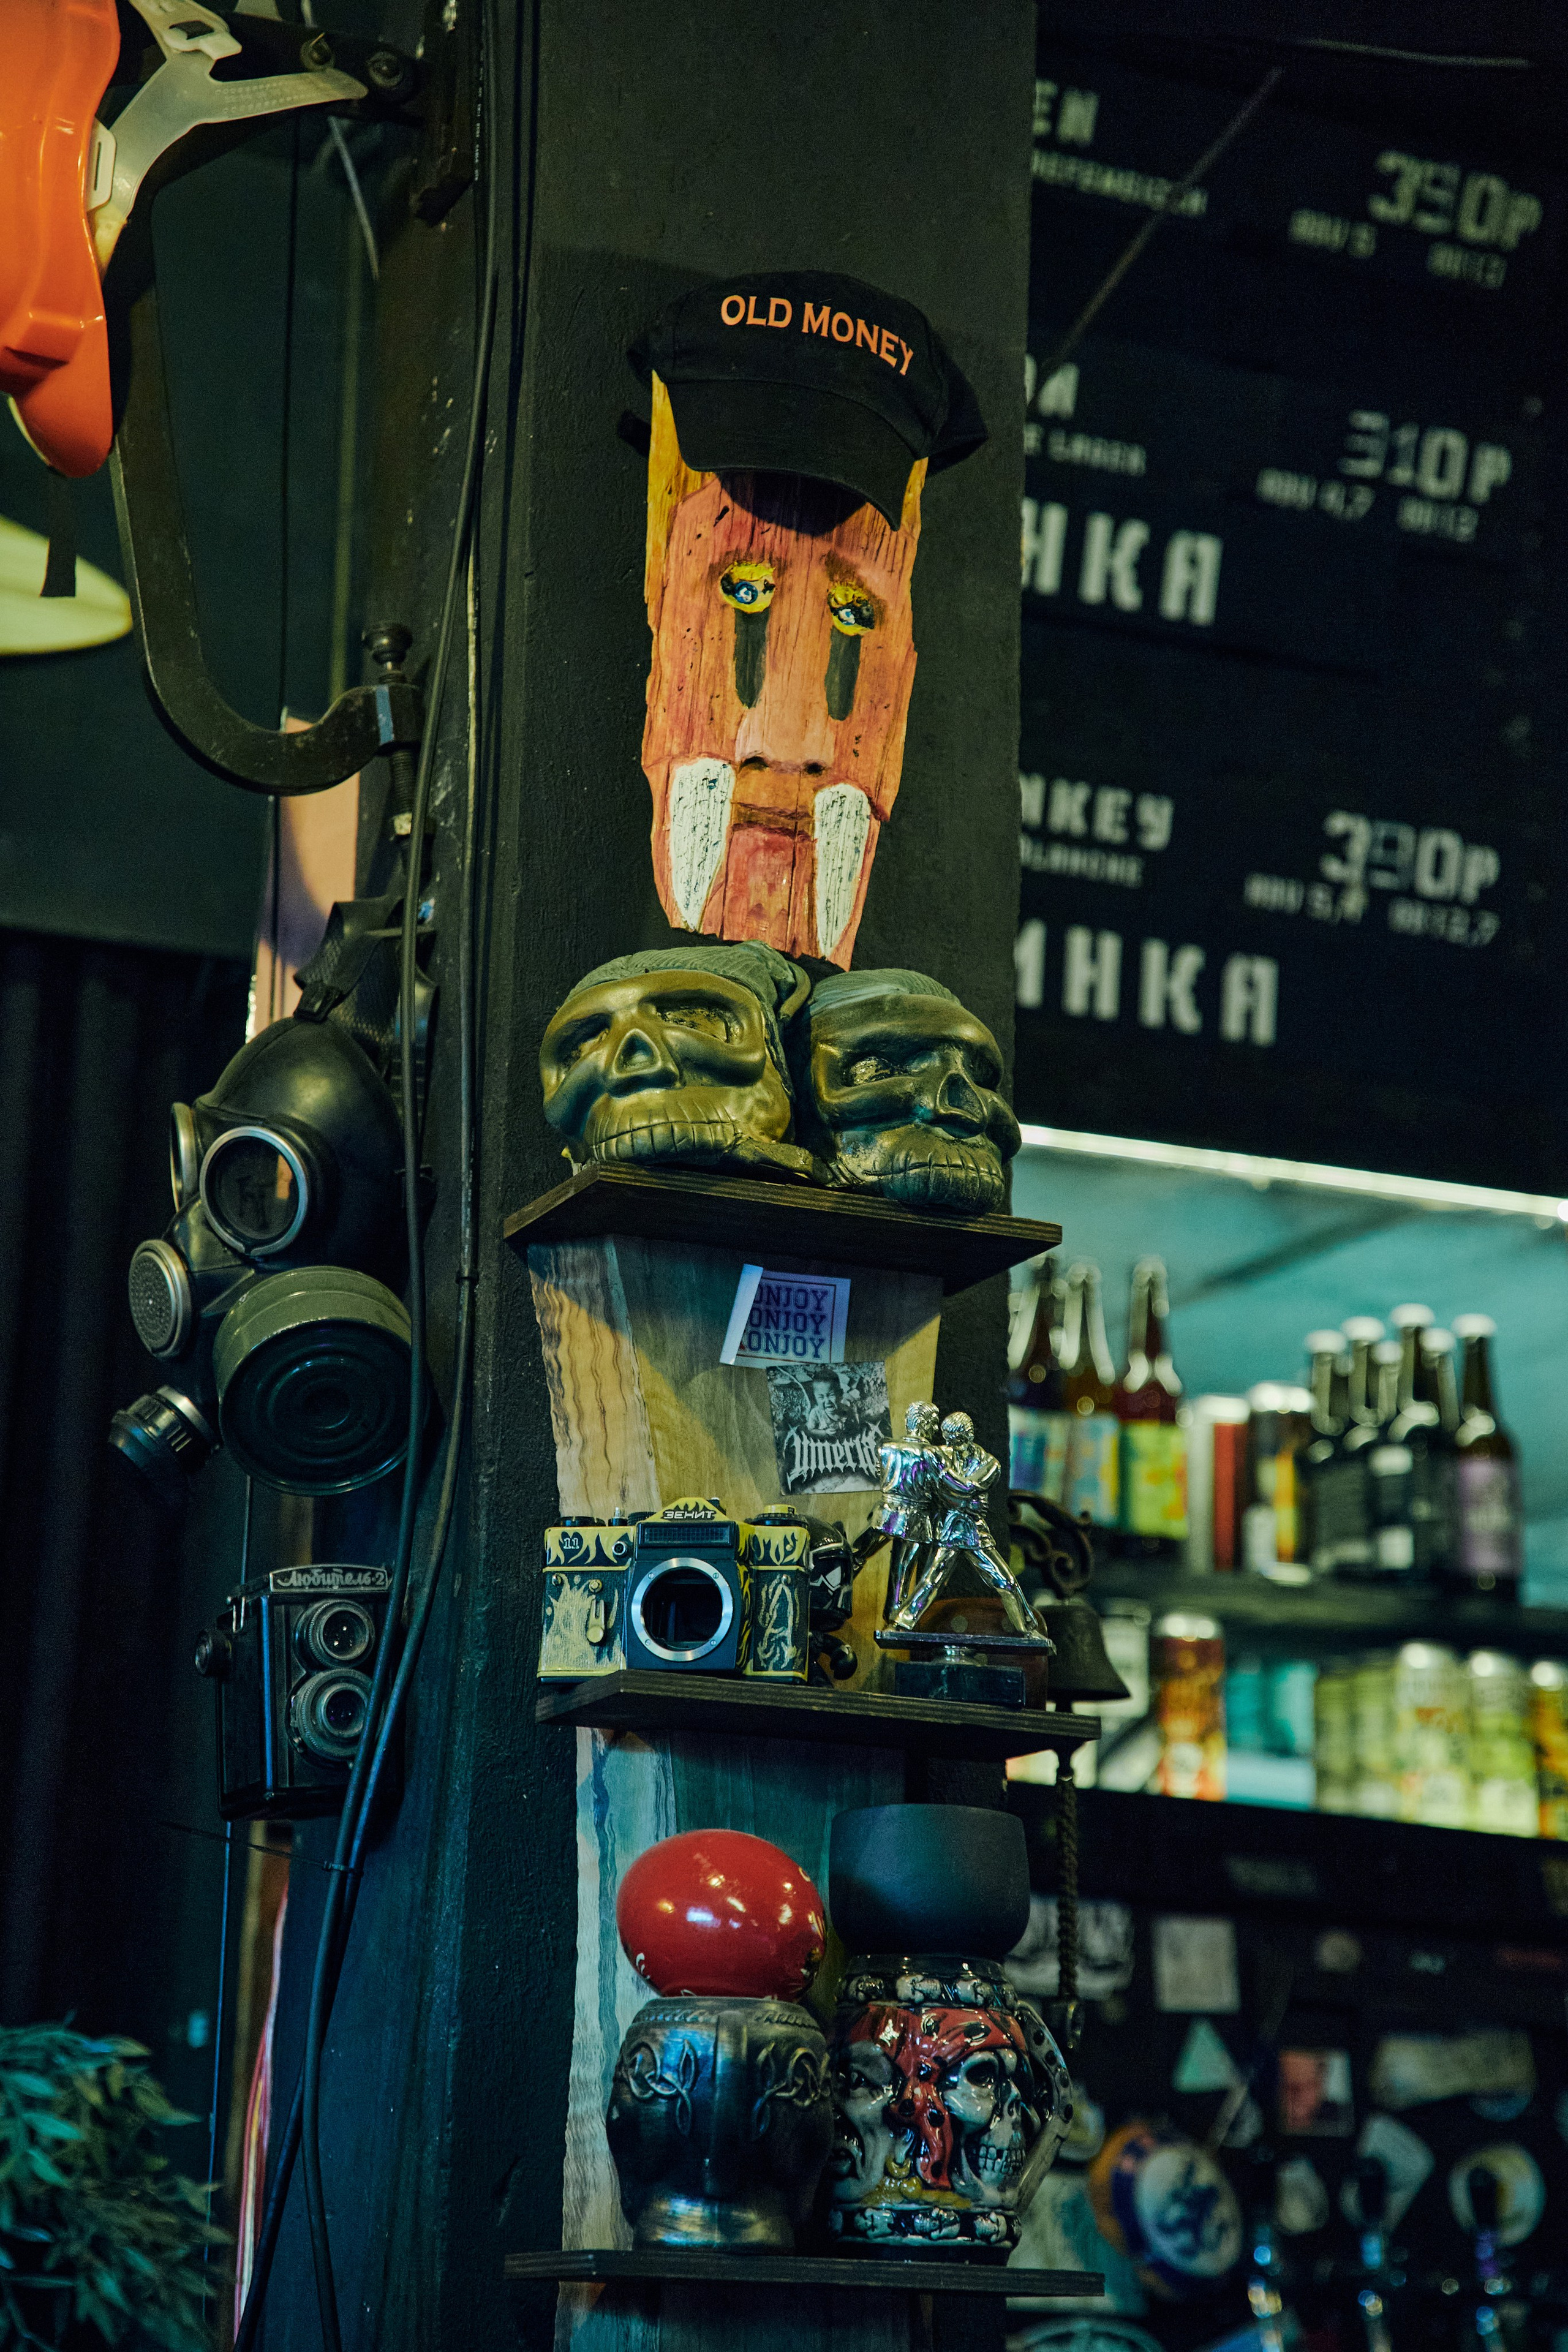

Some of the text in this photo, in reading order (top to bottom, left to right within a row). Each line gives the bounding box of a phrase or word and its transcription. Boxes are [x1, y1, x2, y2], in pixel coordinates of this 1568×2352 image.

[720, 295, 913, 376] OLD MONEY
[749, 1308, 826, 1335] ONJOY
[748, 1330, 826, 1359] ONJOY
[663, 1511, 714, 1520] ЗЕНИТ
[563, 1537, 579, 1549] 11
